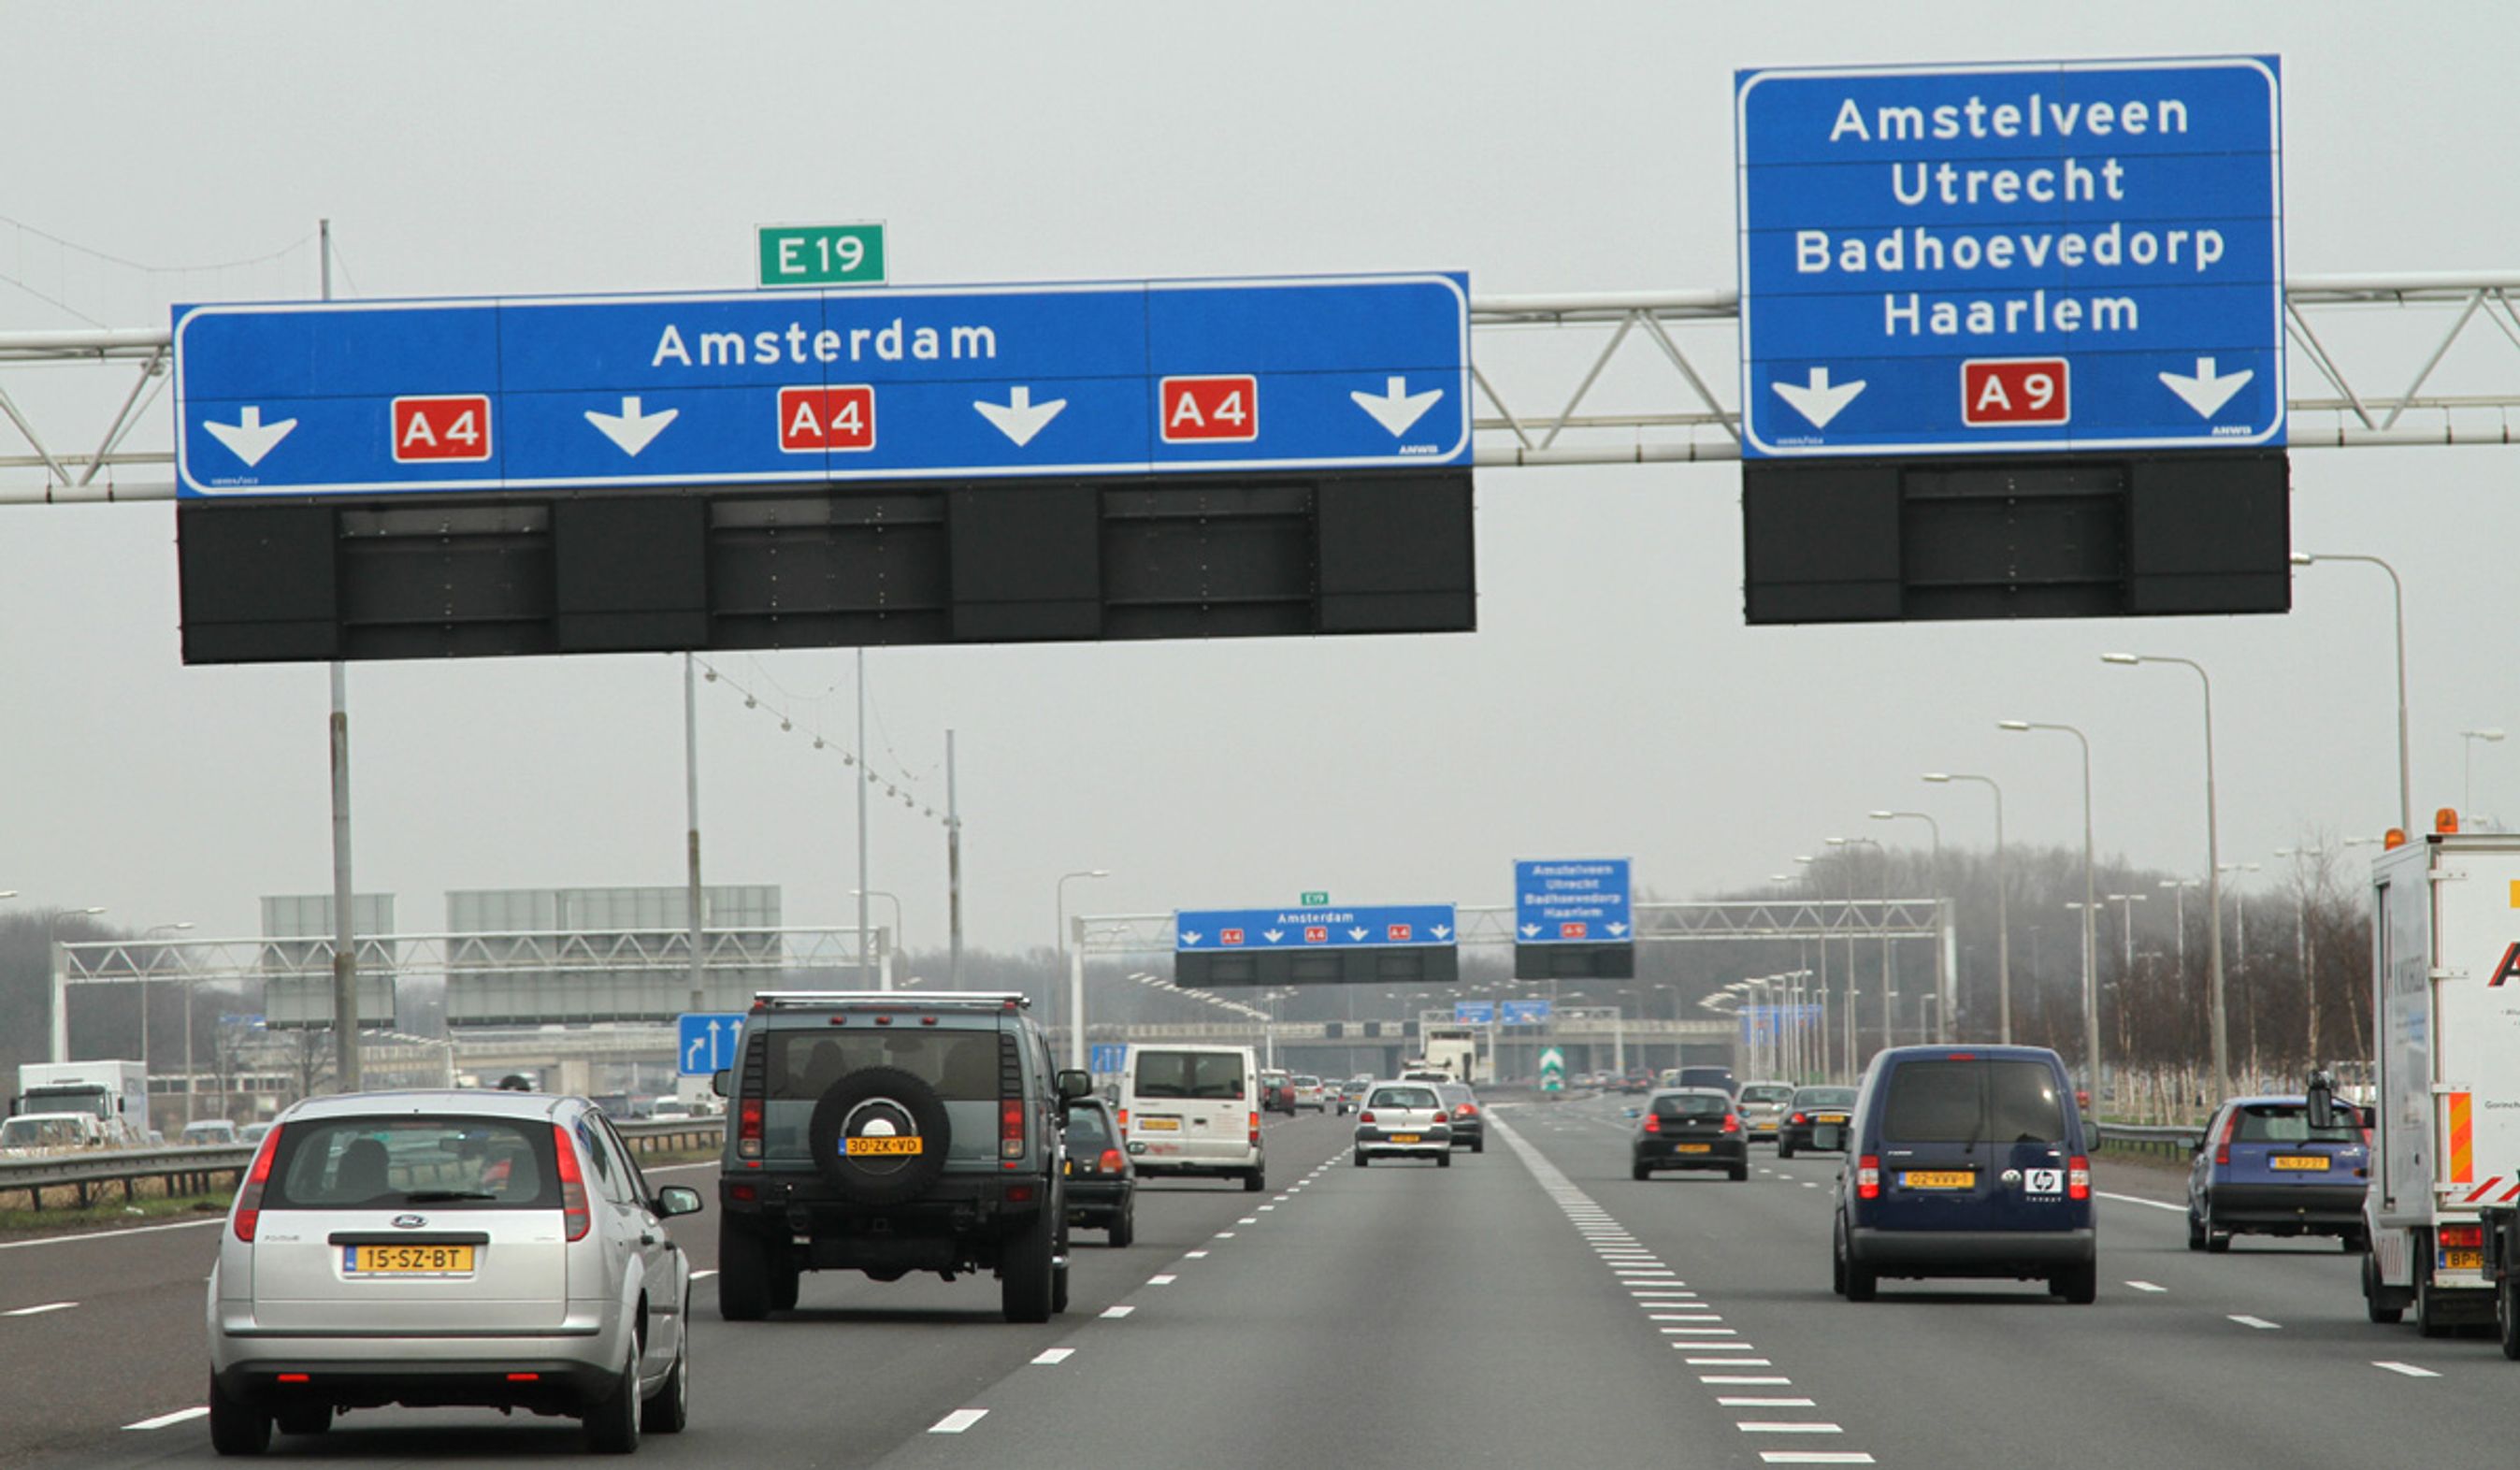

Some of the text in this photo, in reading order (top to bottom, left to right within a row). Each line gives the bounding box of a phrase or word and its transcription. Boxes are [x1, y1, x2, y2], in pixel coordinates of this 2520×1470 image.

[1829, 94, 2187, 142] Amstelveen
[1892, 158, 2124, 206] Utrecht
[779, 235, 865, 274] E19
[1796, 223, 2224, 273] Badhoevedorp
[1884, 289, 2138, 336] Haarlem
[652, 317, 998, 368] Amsterdam
[1171, 390, 1246, 427] A4
[1977, 373, 2054, 411] A9
[403, 410, 480, 447] A4
[788, 400, 864, 438] A4
[1277, 912, 1354, 924] Amsterdam
[367, 1249, 461, 1269] 15-SZ-BT
